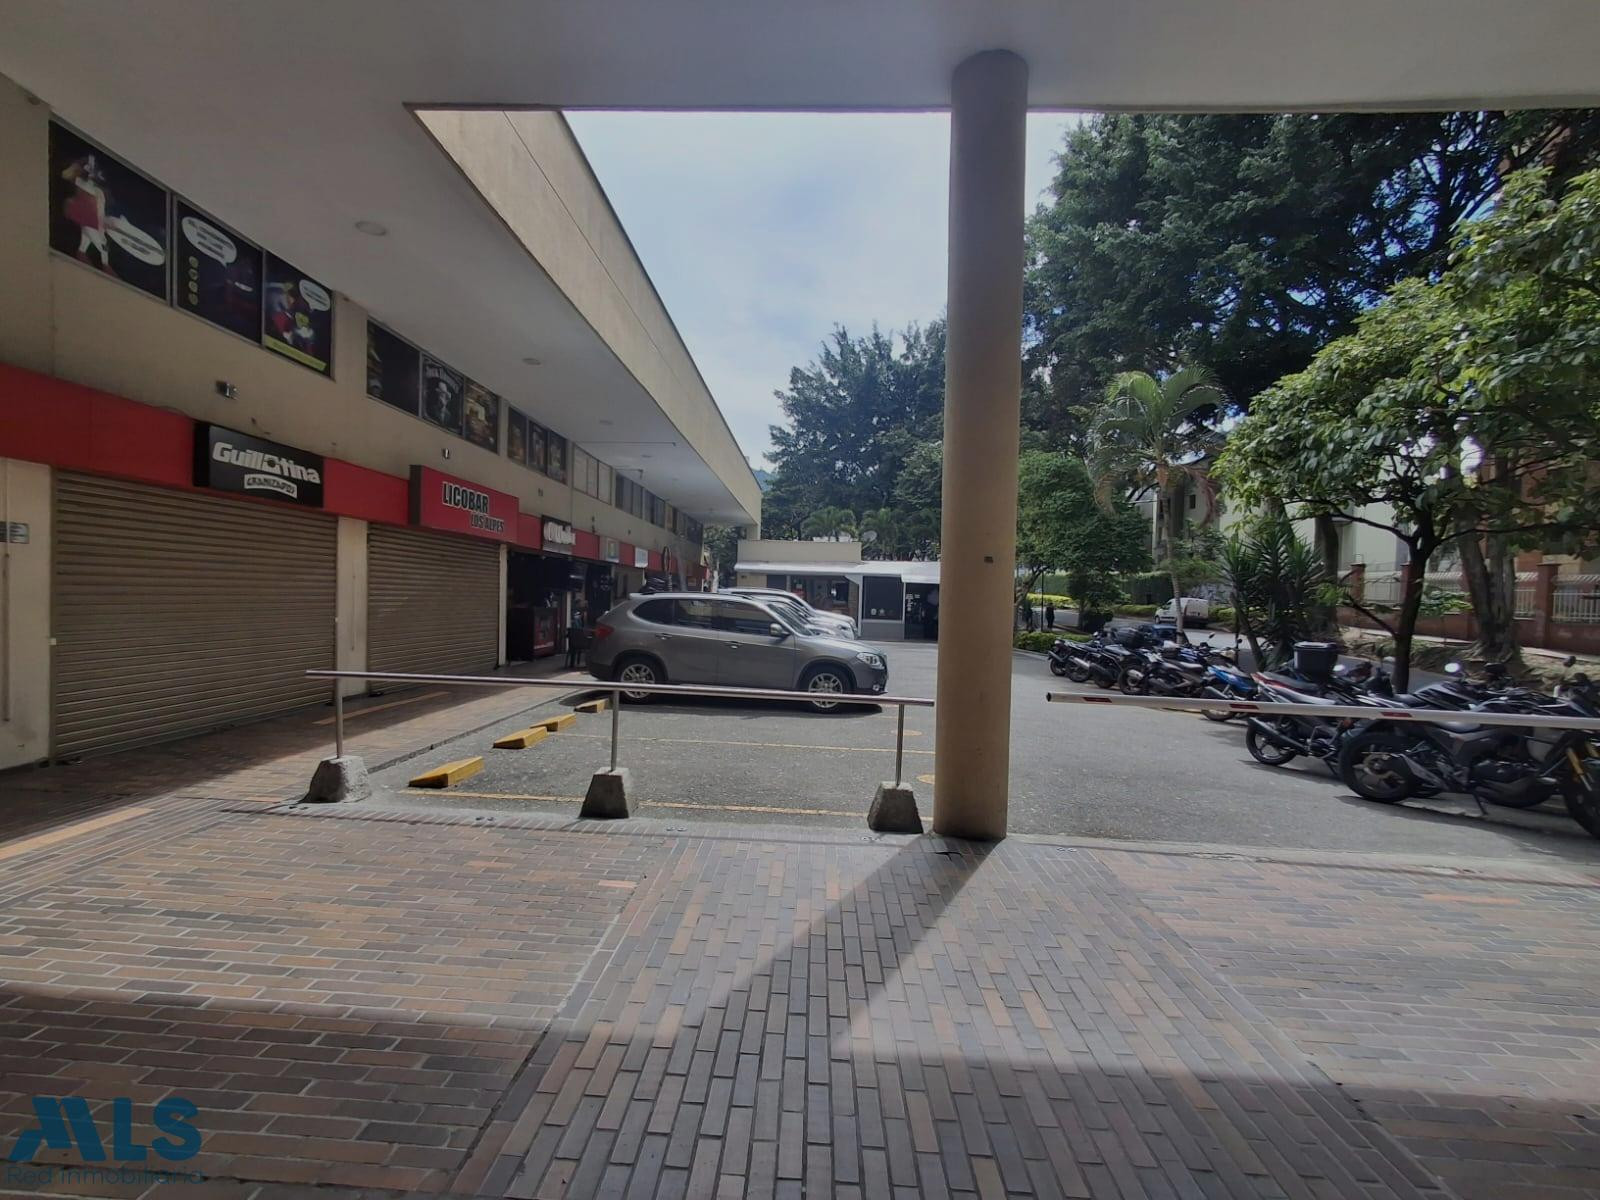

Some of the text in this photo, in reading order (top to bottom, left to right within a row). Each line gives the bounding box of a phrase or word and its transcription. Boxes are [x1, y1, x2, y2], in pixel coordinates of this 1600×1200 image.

[442, 481, 489, 514] LICOBAR
[471, 513, 504, 533] LOS ALPES
